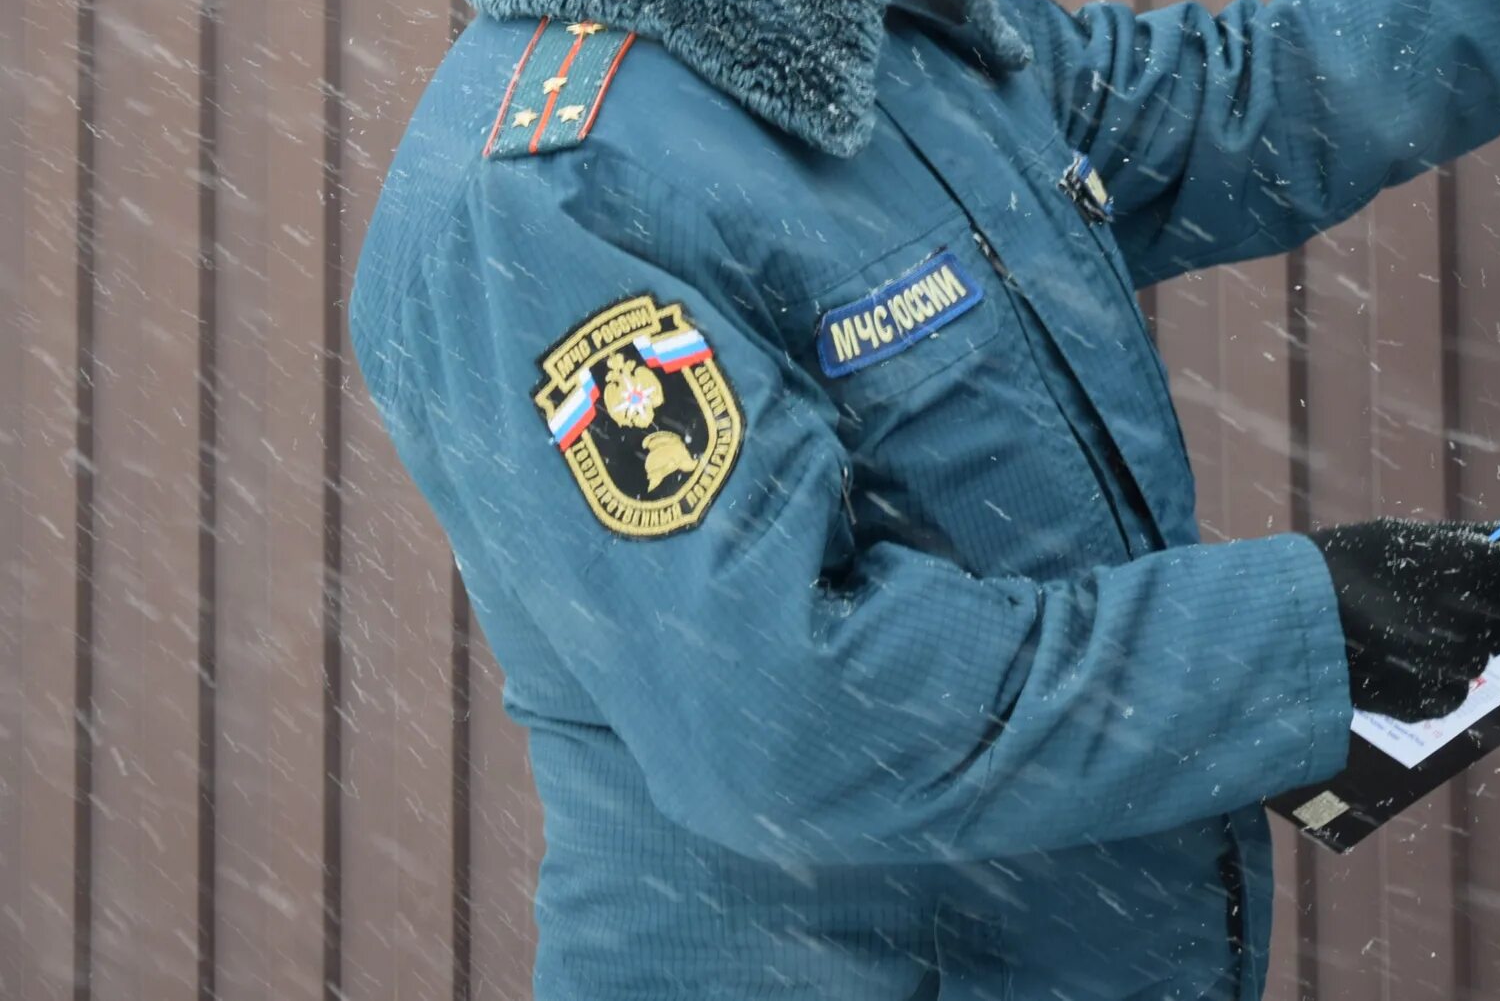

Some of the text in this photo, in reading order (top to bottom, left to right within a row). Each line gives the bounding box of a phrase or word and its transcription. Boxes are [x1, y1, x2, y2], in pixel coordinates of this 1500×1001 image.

[556, 308, 650, 378] МЧС РОССИИ
[830, 305, 893, 362] МЧС
